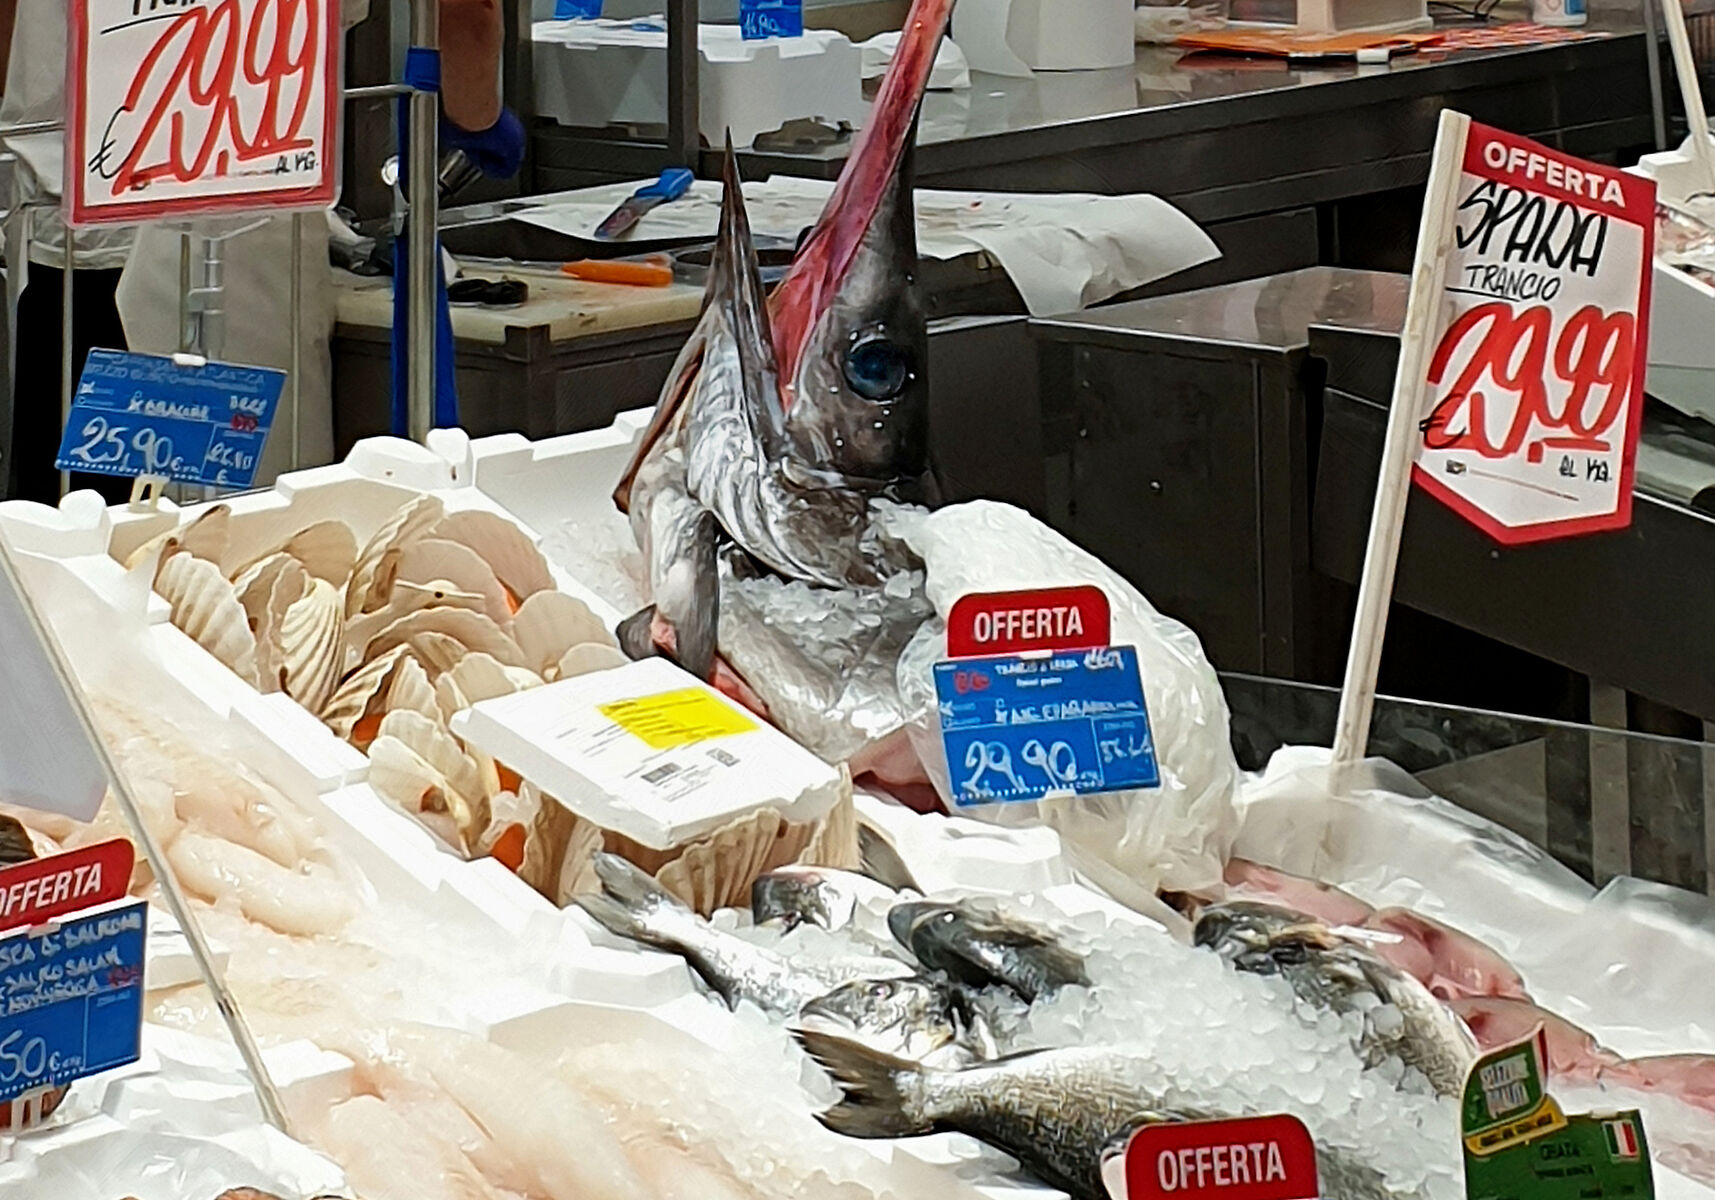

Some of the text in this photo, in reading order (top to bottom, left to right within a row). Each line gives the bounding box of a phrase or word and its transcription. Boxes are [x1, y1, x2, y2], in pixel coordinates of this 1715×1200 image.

[1483, 140, 1626, 209] OFFERTA
[1456, 180, 1609, 278] SPADA
[1465, 264, 1561, 302] TRANCIO
[974, 606, 1084, 643] OFFERTA
[1158, 1140, 1287, 1192] OFFERTA
